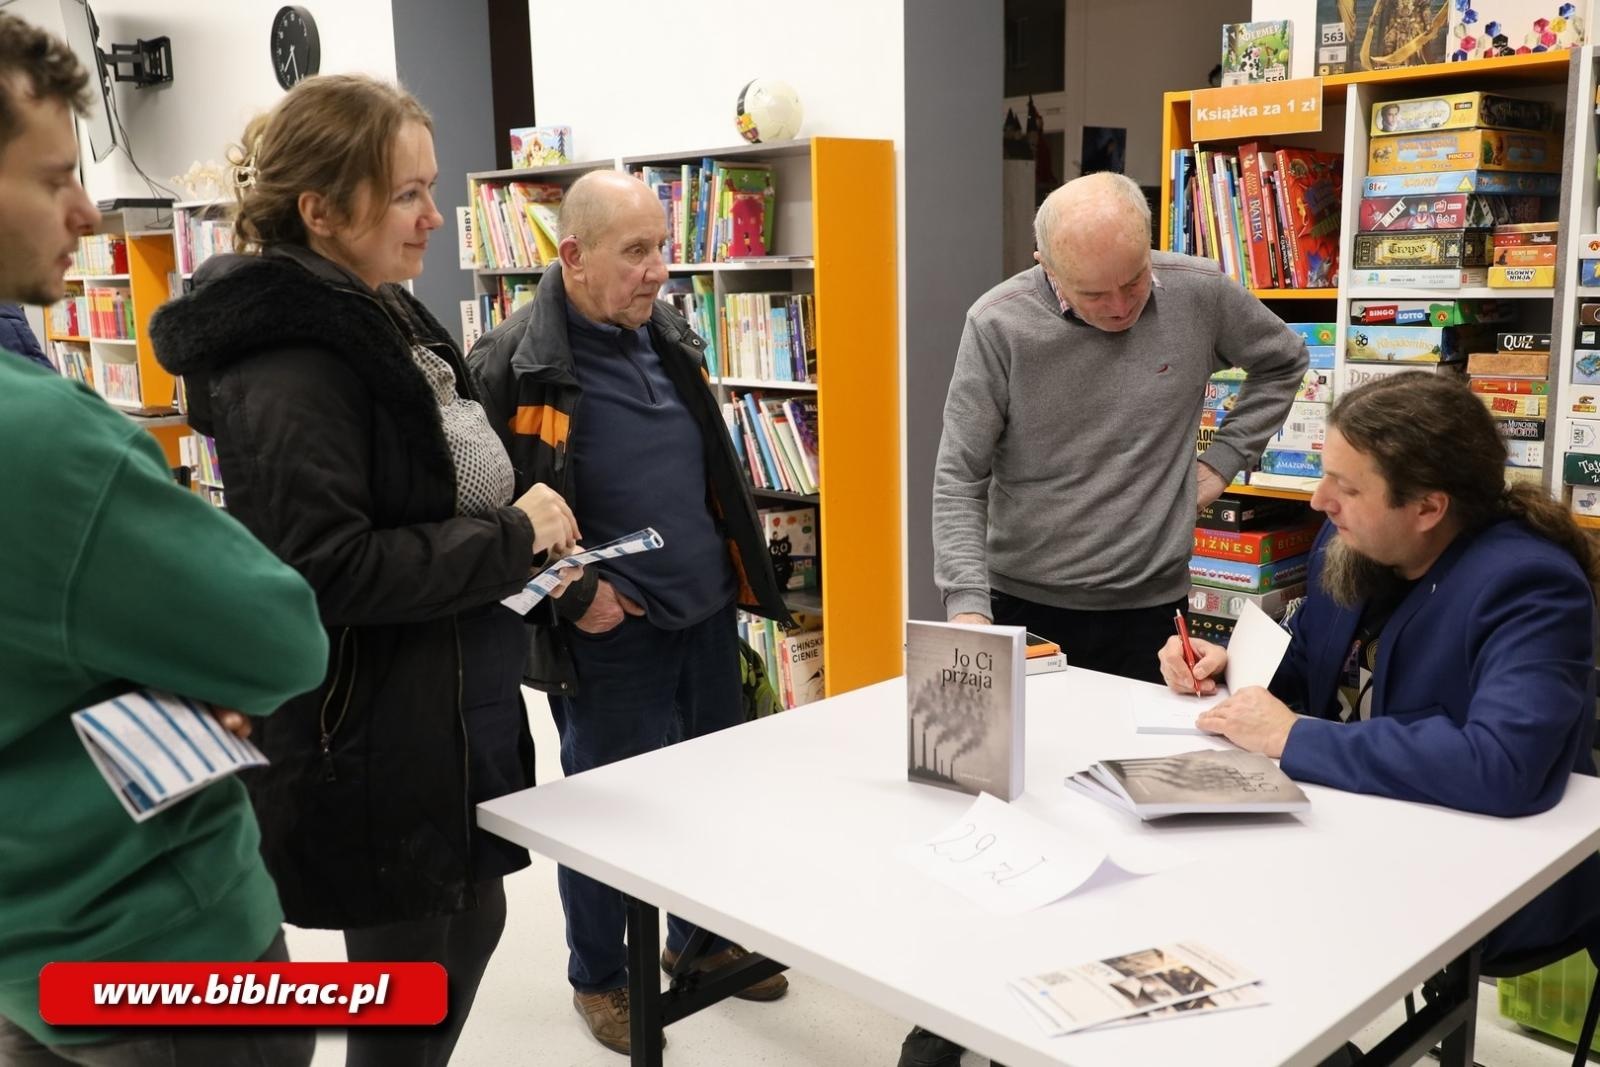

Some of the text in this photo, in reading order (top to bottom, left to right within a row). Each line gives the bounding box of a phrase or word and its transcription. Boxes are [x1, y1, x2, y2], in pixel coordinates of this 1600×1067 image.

[1323, 32, 1344, 43] 563
[1196, 98, 1317, 122] Książka za 1 zł
[465, 210, 473, 249] HOBBY
[1388, 242, 1428, 259] Troyes
[1369, 308, 1424, 320] BINGO LOTTO
[1503, 334, 1533, 350] QUIZ
[1508, 419, 1538, 428] MUNCHKIN
[1276, 460, 1315, 470] AMAZONIA
[1577, 459, 1600, 474] Taj
[792, 649, 819, 664] CIENIE
[952, 648, 993, 672] Jo Ci
[926, 824, 997, 863] 29
